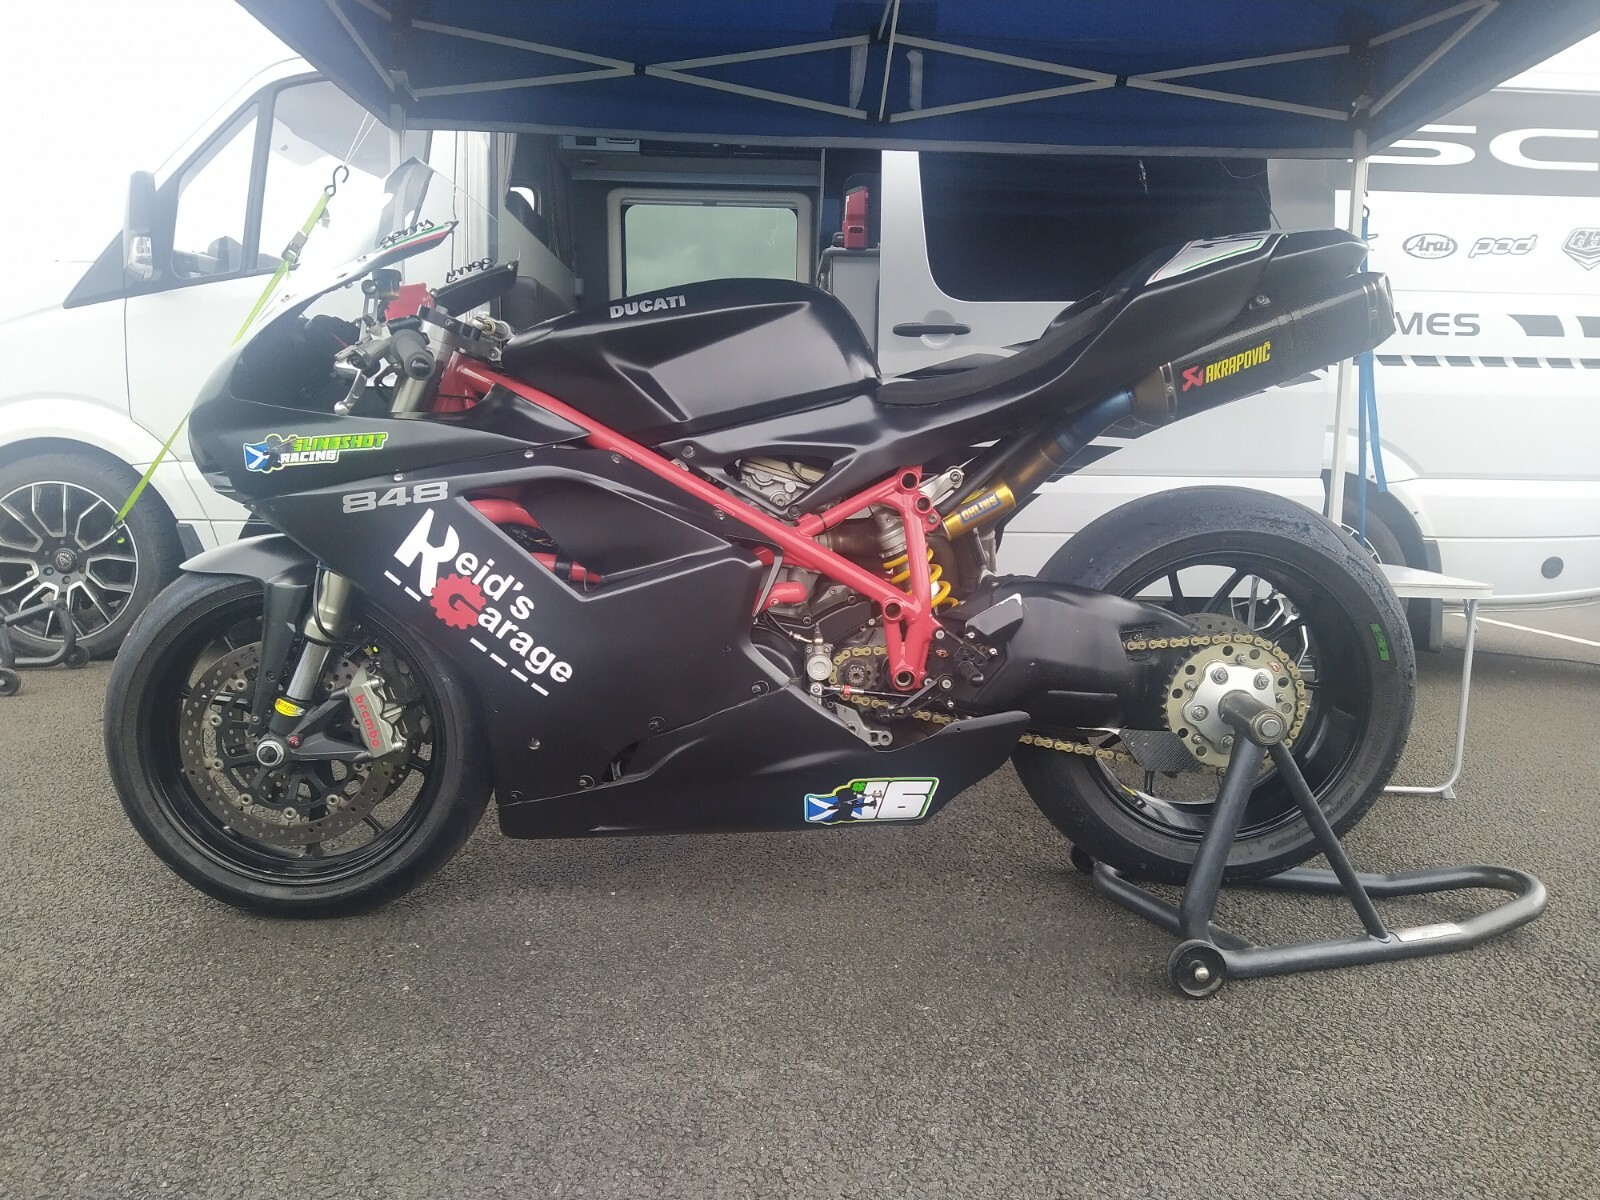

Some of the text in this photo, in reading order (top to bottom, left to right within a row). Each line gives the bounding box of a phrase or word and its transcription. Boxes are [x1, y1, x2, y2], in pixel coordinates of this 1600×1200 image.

[1406, 236, 1452, 252] Arai
[609, 294, 686, 319] DUCATI
[280, 449, 338, 464] RACING
[293, 433, 387, 452] SLINGSHOT
[342, 481, 449, 514] 848
[393, 507, 535, 620] Reid's
[446, 593, 573, 683] Garage
[354, 694, 380, 748] brembo
